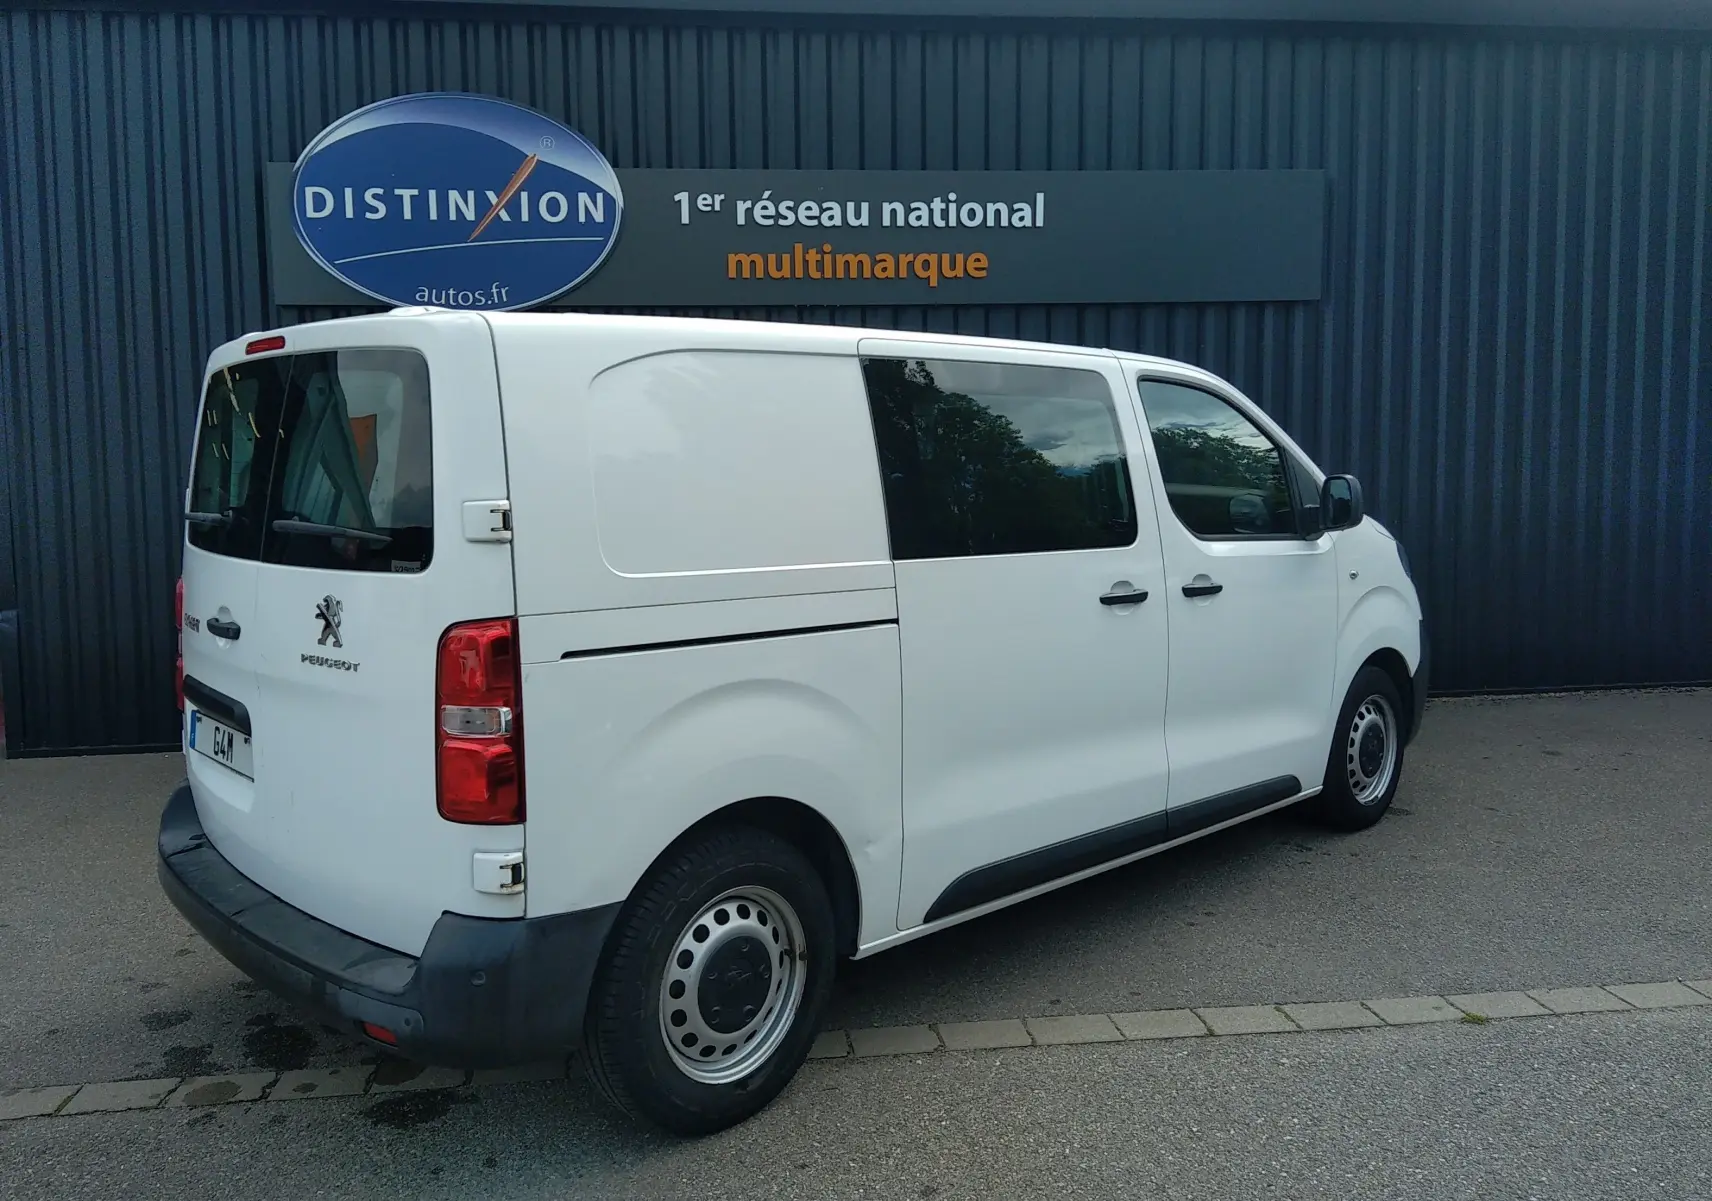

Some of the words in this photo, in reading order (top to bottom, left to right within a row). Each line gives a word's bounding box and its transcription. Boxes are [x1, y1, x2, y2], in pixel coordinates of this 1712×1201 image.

[304, 186, 605, 224] DISTINXION
[673, 191, 725, 225] 1er
[735, 190, 870, 227] réseau
[881, 192, 1045, 228] national
[727, 243, 989, 288] multimarque
[415, 282, 510, 306] autos.fr
[300, 653, 360, 672] PEUGEOT
[213, 725, 234, 764] G4M
